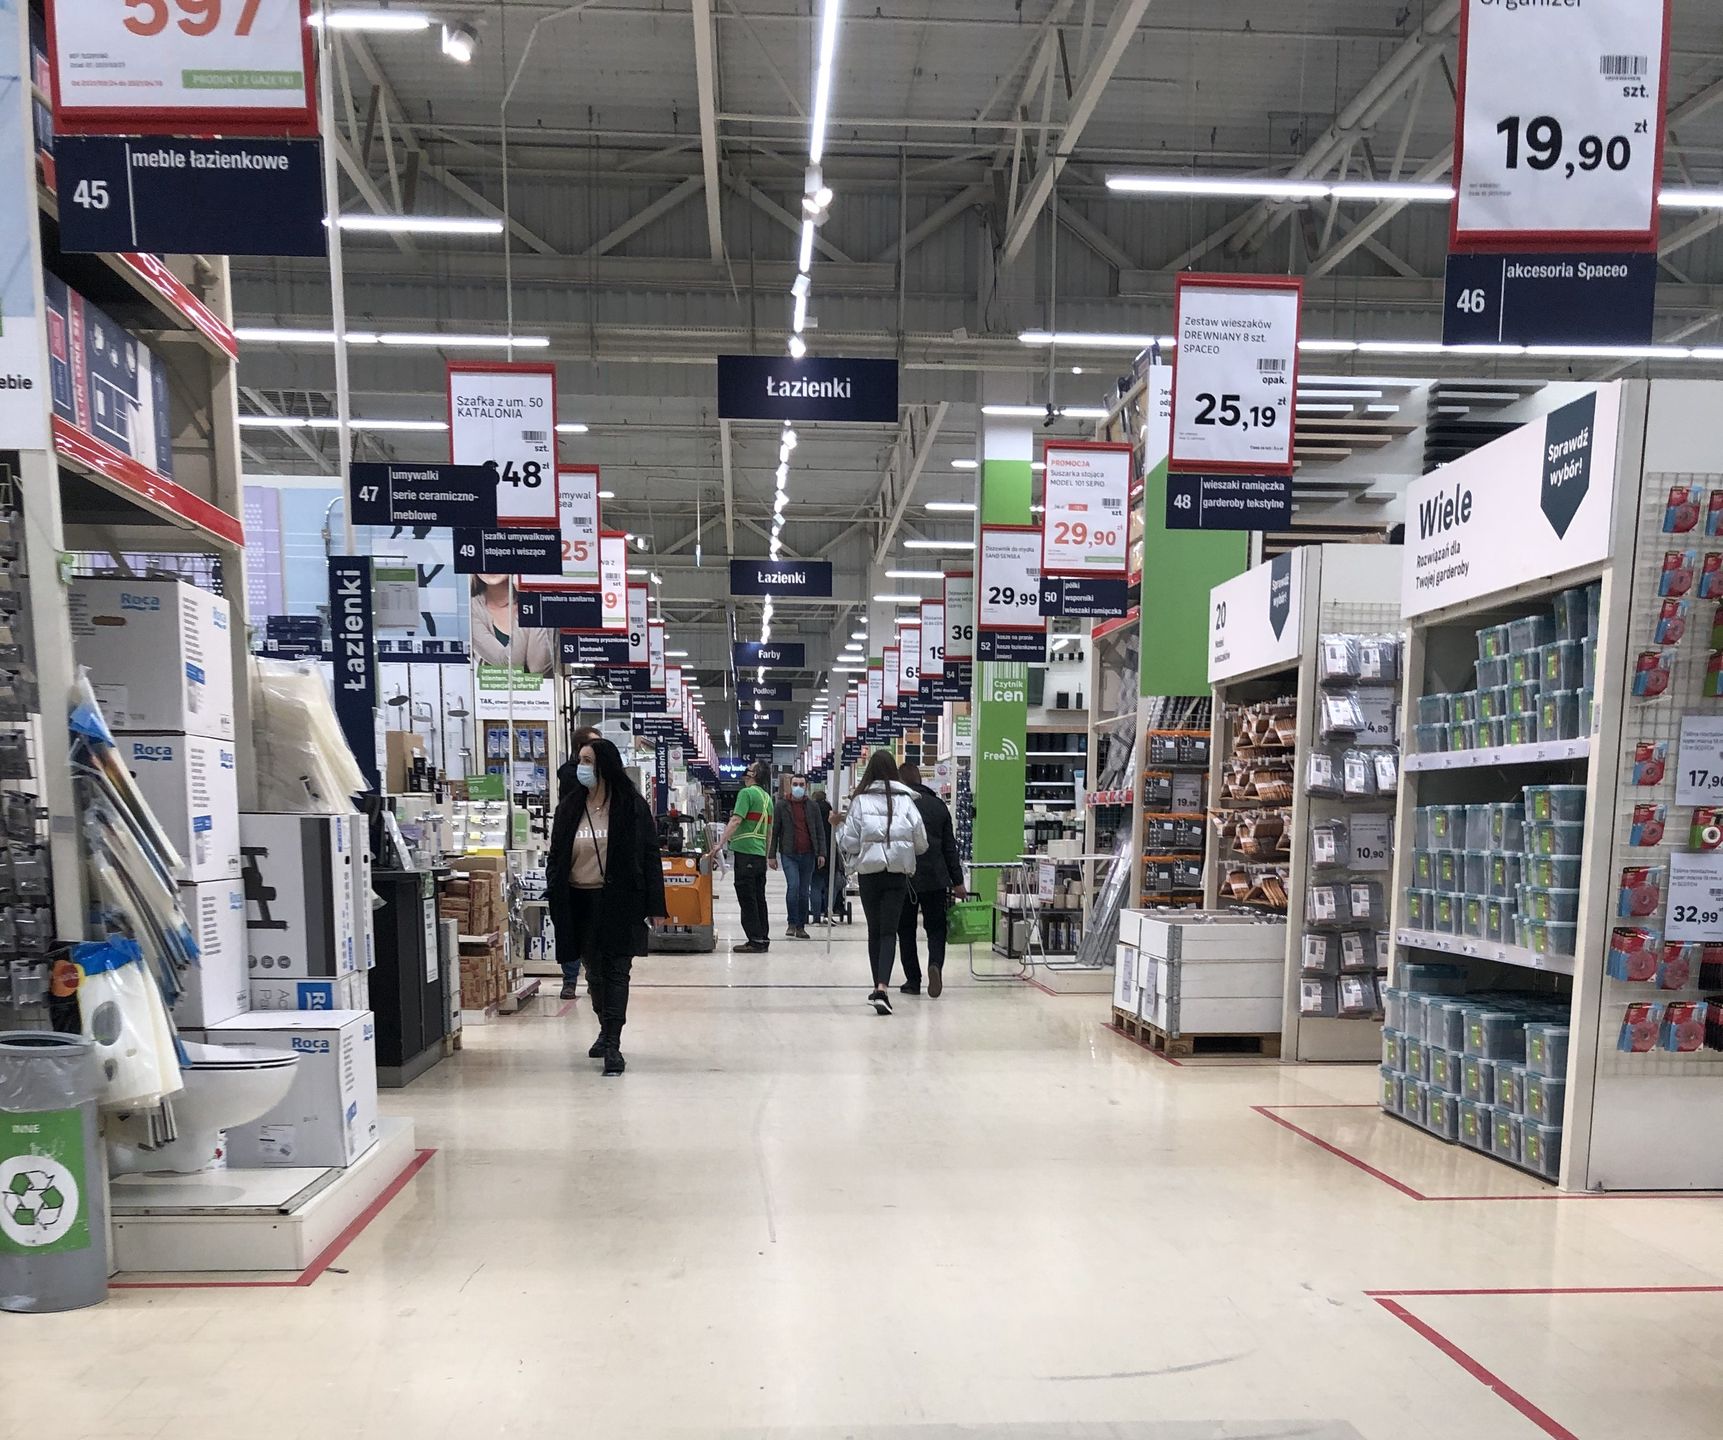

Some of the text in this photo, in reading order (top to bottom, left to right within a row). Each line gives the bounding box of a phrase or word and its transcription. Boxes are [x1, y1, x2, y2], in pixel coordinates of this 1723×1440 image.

[1623, 84, 1649, 98] szt.
[1634, 119, 1648, 134] zł
[1496, 115, 1631, 179] 19,90
[132, 150, 288, 171] meble łazienkowe
[73, 180, 109, 209] 45
[1506, 261, 1628, 280] akcesoria Spaceo
[1456, 288, 1485, 313] 46
[1185, 316, 1271, 329] Zestaw wieszaków
[1184, 330, 1267, 343] DREWNIANY 8 szt.
[1184, 344, 1220, 354] SPACEO
[766, 375, 851, 399] Łazienki
[1262, 375, 1287, 386] opak.
[456, 395, 543, 408] Szafka z um. 50
[1277, 396, 1286, 406] zł
[456, 407, 523, 419] KATALONIA
[1194, 393, 1276, 431] 25,19
[1547, 426, 1589, 462] Sprawdź
[1050, 459, 1090, 468] PROMOCJA
[392, 470, 439, 483] umywalki
[1050, 469, 1105, 479] Suszarka stojąca
[1549, 456, 1583, 487] wybór!
[1050, 479, 1105, 488] MODEL 101 SEPIO
[1203, 480, 1285, 492] wieszaki ramiączka
[359, 486, 379, 502] 47
[392, 491, 479, 502] serie ceramiczno-
[1173, 494, 1191, 510] 48
[1202, 498, 1285, 510] garderoby tekstylne
[393, 510, 437, 521] meblowe
[1419, 482, 1473, 541] Wiele
[484, 532, 555, 543] szafki umywalkowe
[1054, 521, 1116, 548] 29,90
[459, 544, 476, 557] 49
[484, 547, 511, 557] stojące
[517, 547, 546, 558] wiszące
[1416, 540, 1461, 569] Rozwiązań dla
[757, 571, 806, 585] Łazienki
[1415, 559, 1470, 590] Twojej garderoby
[1064, 581, 1081, 590] półki
[120, 592, 160, 606] Roca
[604, 592, 618, 609] 9
[988, 586, 1037, 608] 29,99
[1044, 591, 1057, 602] 50
[1064, 593, 1094, 602] wsporniki
[522, 604, 534, 615] 51
[1064, 606, 1122, 616] wieszaki ramiączka
[1215, 600, 1227, 631] 20
[336, 569, 367, 692] Łazienki
[630, 632, 641, 647] 9
[980, 641, 991, 650] 52
[563, 644, 575, 654] 53
[758, 650, 781, 660] Farby
[994, 680, 1023, 688] Czytnik
[994, 690, 1024, 702] cen
[133, 742, 172, 756] Roca
[983, 751, 1005, 760] Free
[658, 746, 667, 785] Łazienki
[1357, 846, 1385, 860] 10,90
[1673, 905, 1718, 925] 32,99
[291, 1036, 329, 1049] Roca
[11, 1124, 41, 1134] INNE
